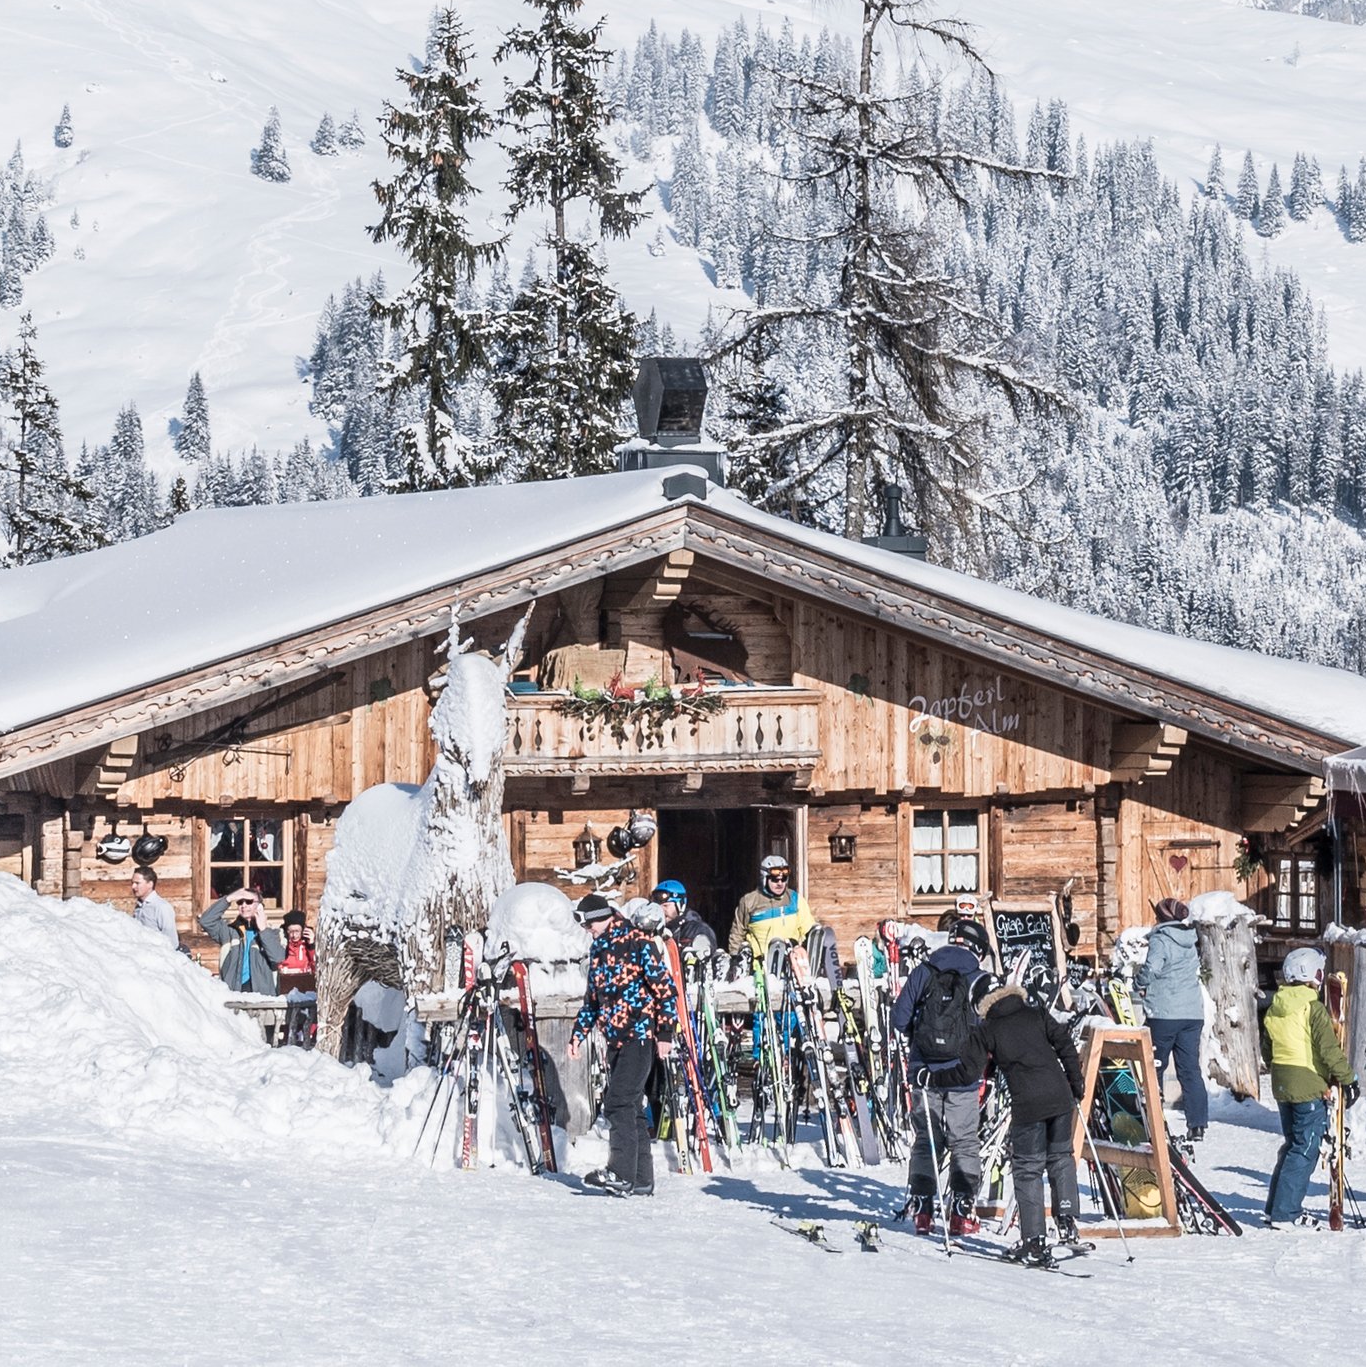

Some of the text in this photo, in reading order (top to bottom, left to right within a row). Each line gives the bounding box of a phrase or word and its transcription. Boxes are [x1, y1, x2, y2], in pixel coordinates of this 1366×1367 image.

[908, 675, 1006, 733] Zapferl
[970, 709, 1020, 750] Alm
[829, 943, 843, 987] RMADA
